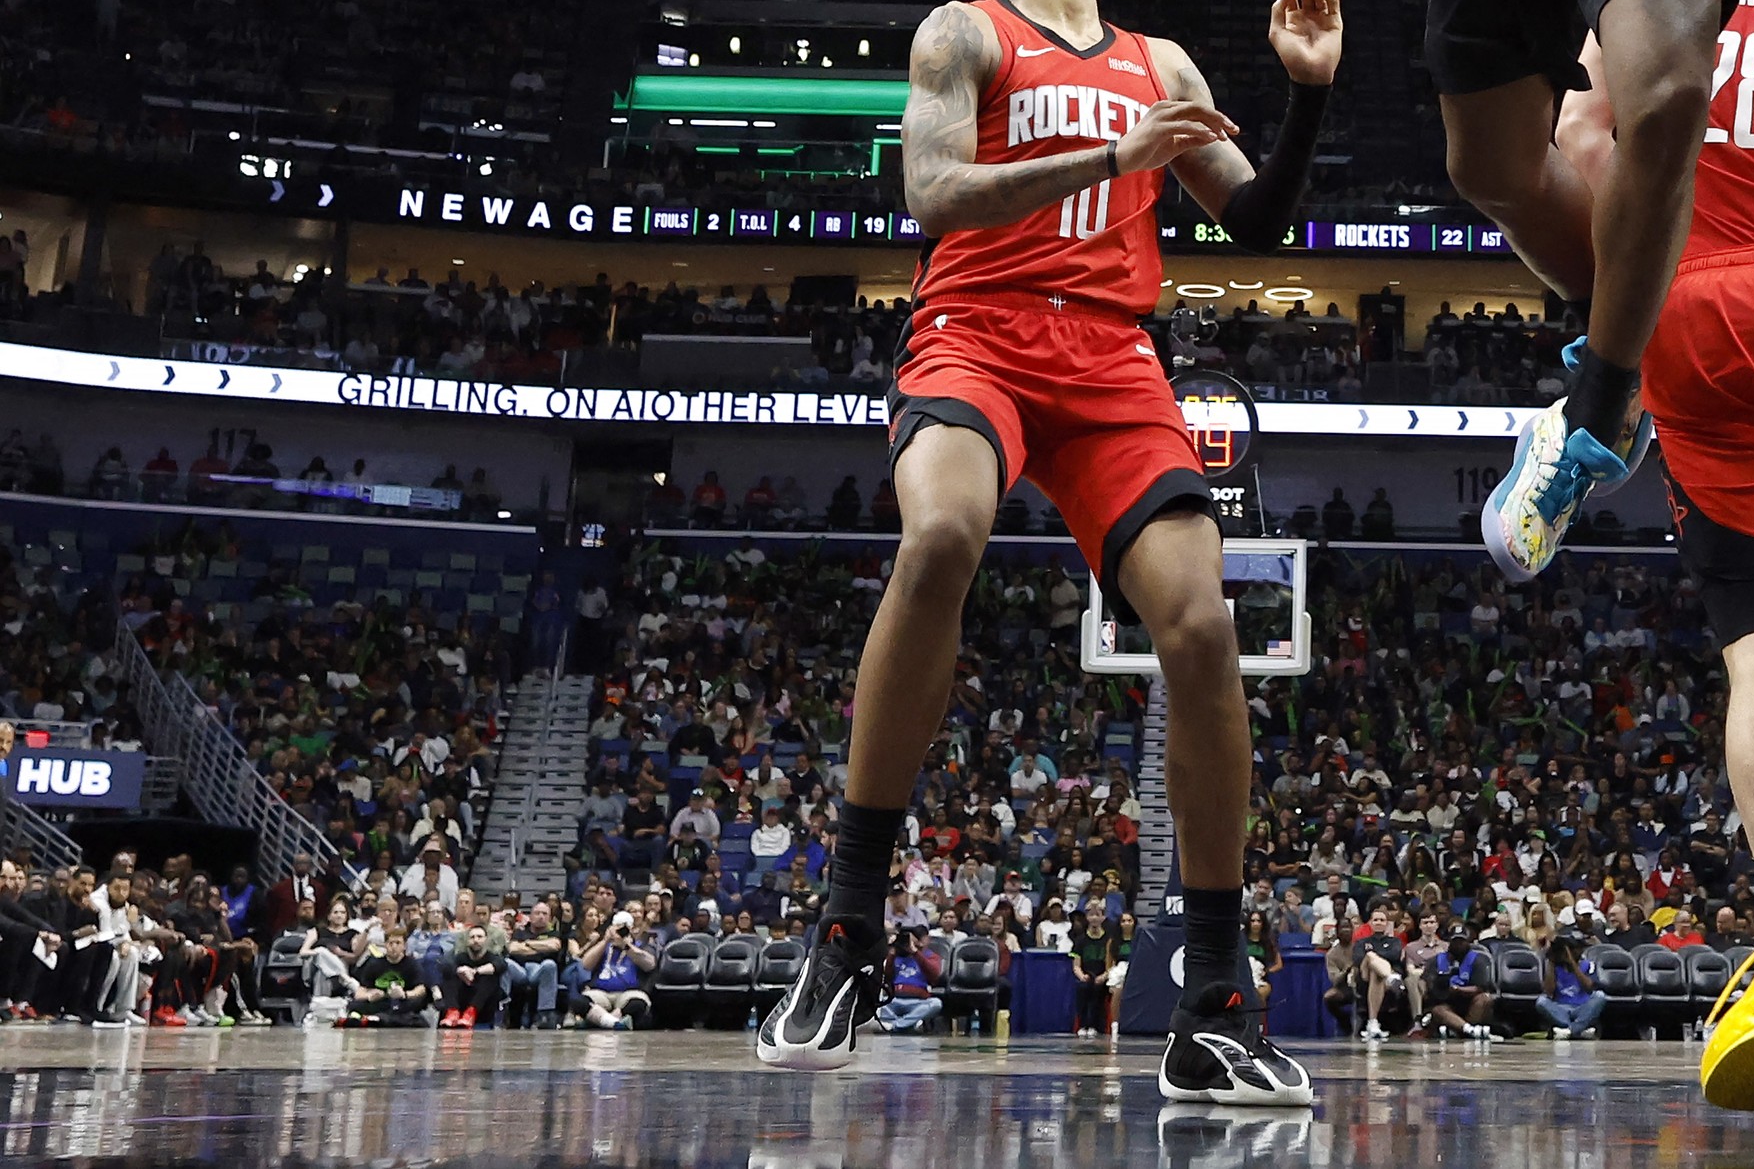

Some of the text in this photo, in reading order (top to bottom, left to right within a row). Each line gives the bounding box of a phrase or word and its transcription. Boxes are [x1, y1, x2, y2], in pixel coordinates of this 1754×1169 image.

[1007, 84, 1151, 149] ROCKET
[400, 189, 633, 233] NEWAGE
[654, 212, 689, 229] FOULS
[707, 214, 719, 230] 2
[788, 215, 801, 232] 4
[864, 216, 885, 234] 19
[1194, 223, 1234, 243] 8:3
[1334, 224, 1502, 248] ROCKETS 22 AST
[337, 375, 528, 415] GRILLING.
[546, 387, 598, 419] ON
[793, 393, 885, 424] LEVE
[1453, 466, 1499, 504] 119
[15, 757, 112, 796] HUB
